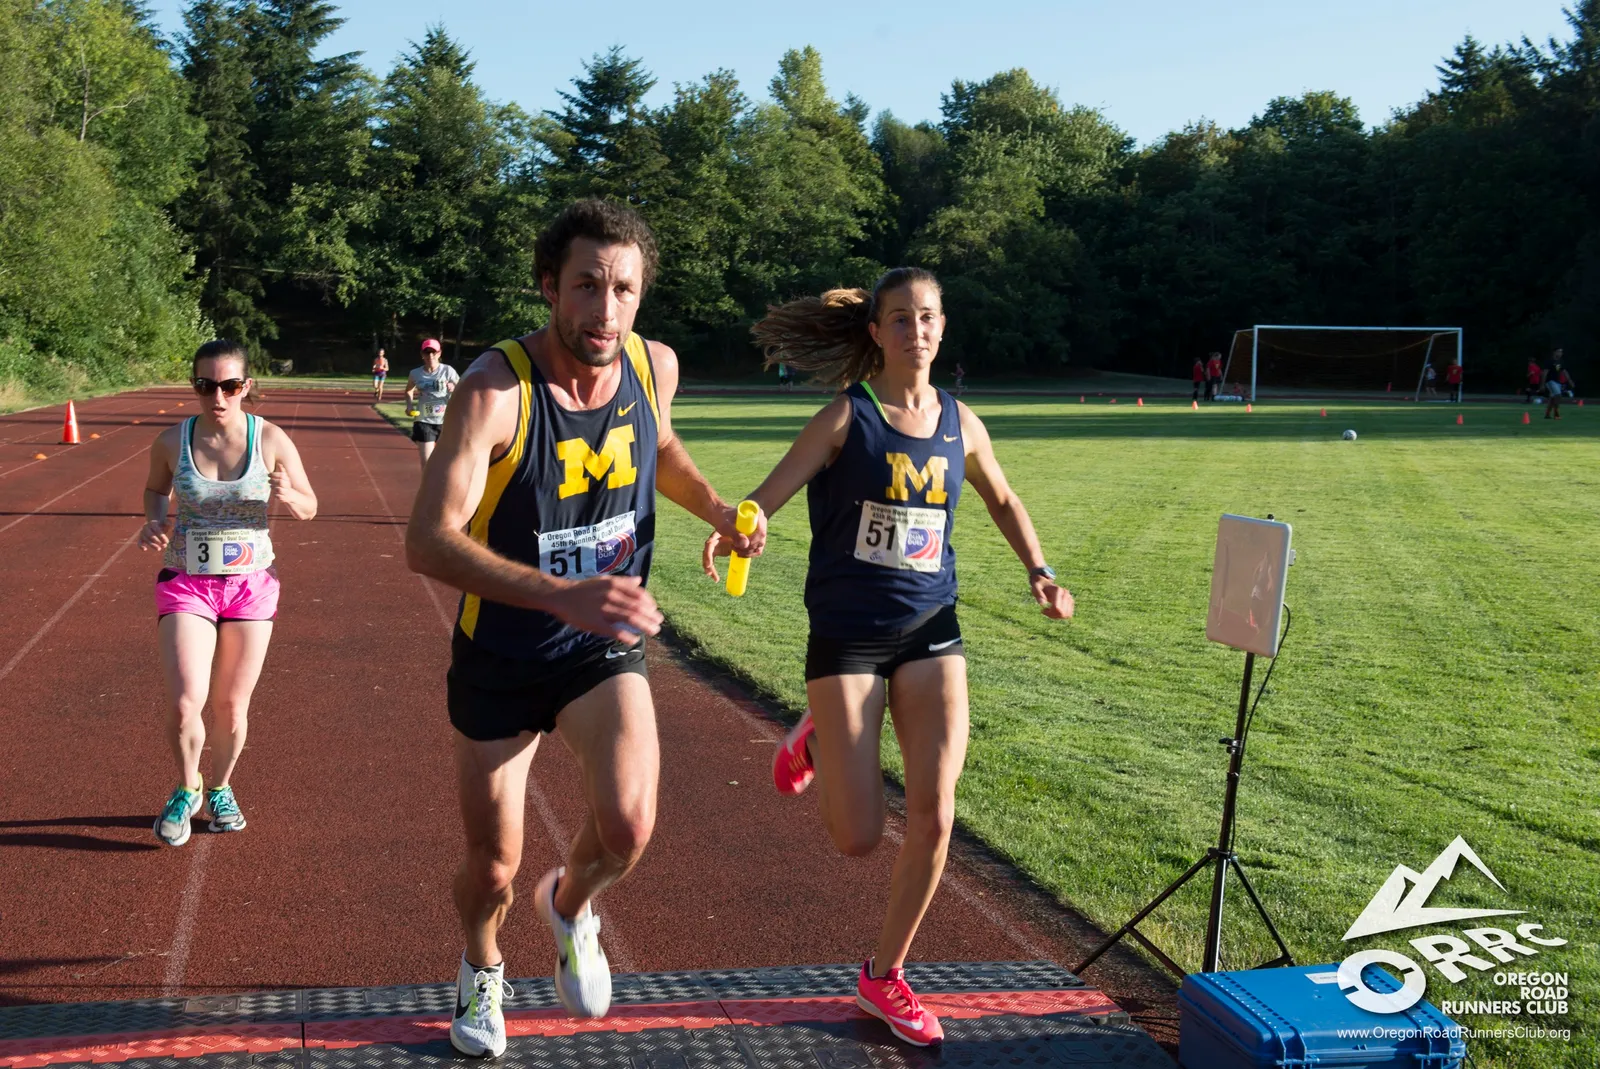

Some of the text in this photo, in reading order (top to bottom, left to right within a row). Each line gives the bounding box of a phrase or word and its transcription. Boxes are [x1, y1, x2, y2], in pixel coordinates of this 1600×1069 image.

[557, 424, 637, 499] M
[886, 452, 948, 504] M
[547, 531, 571, 541] Oregon
[573, 528, 591, 537] Road
[569, 536, 597, 546] Running
[866, 520, 896, 551] 51
[198, 543, 209, 563] 3
[550, 547, 583, 577] 51
